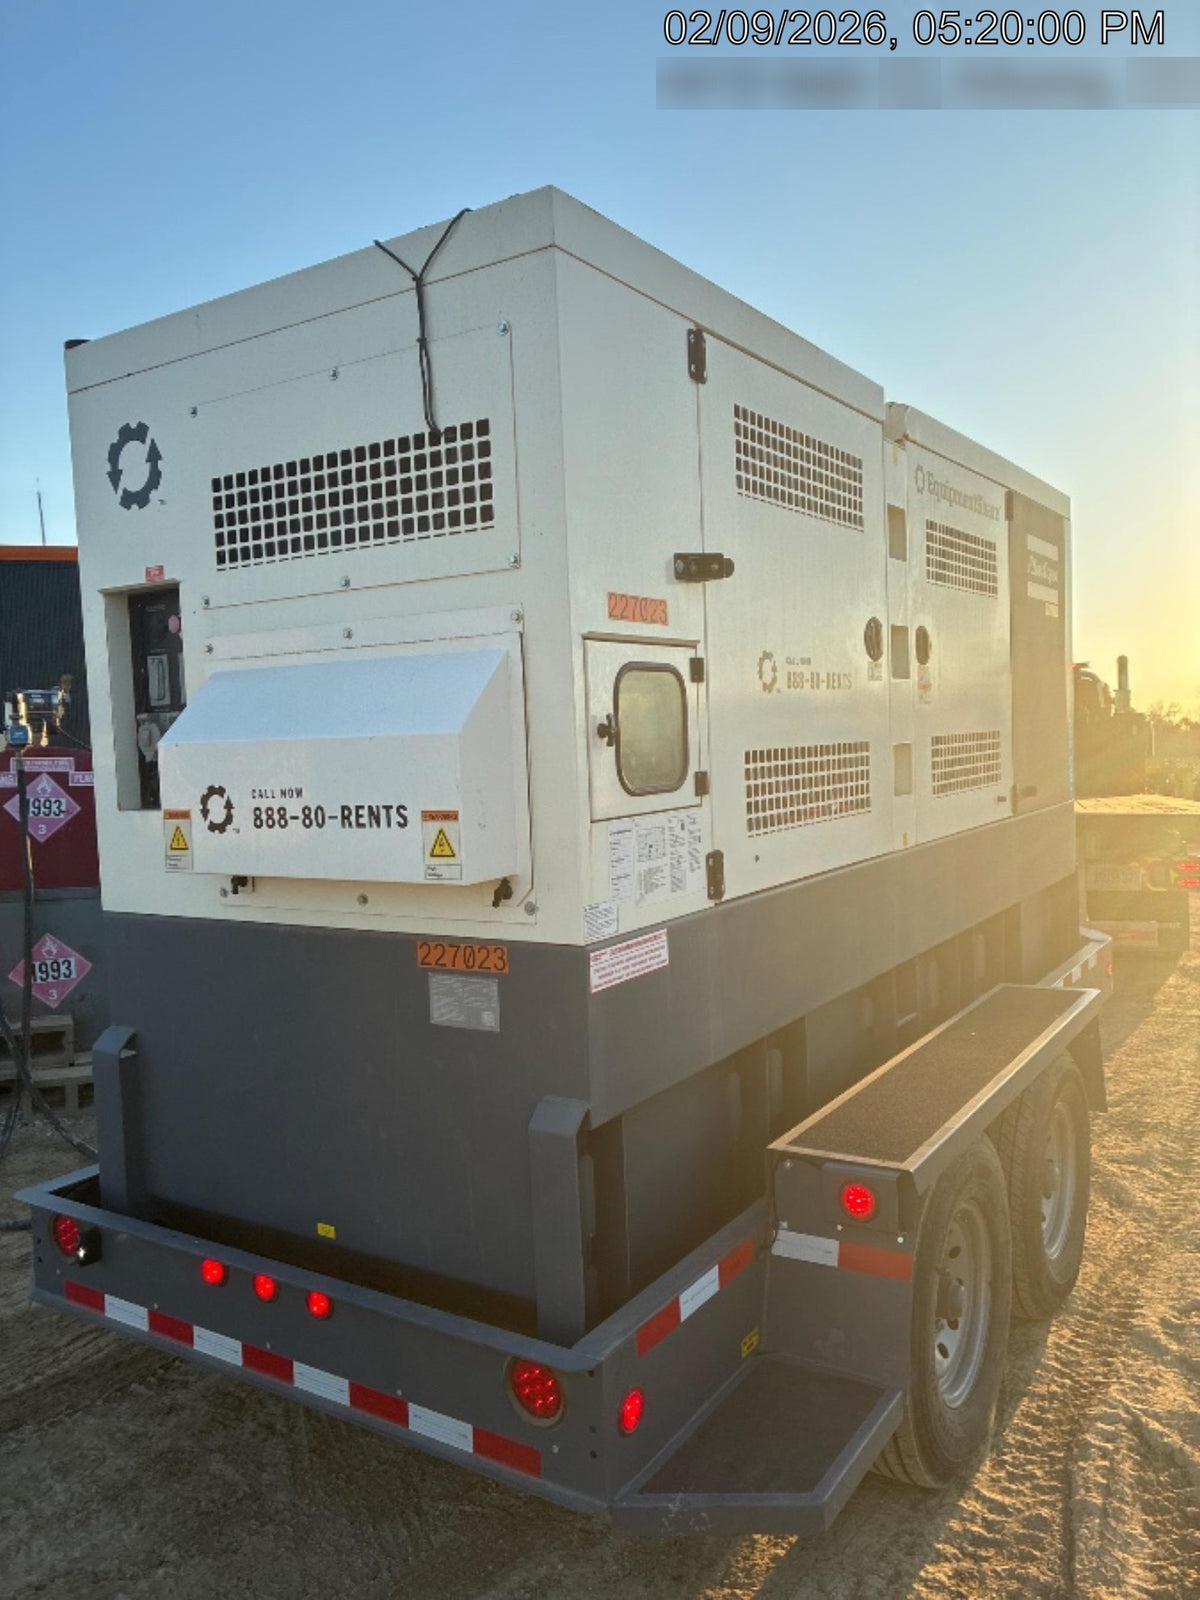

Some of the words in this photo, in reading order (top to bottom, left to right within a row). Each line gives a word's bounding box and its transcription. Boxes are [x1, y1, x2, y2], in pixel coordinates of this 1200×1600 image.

[608, 592, 669, 626] 227023
[251, 788, 277, 799] CALL
[279, 787, 304, 799] NOW
[252, 804, 409, 829] 888-80-RENTS
[38, 824, 47, 835] 3
[418, 942, 507, 972] 227023
[48, 990, 58, 1000] 3
